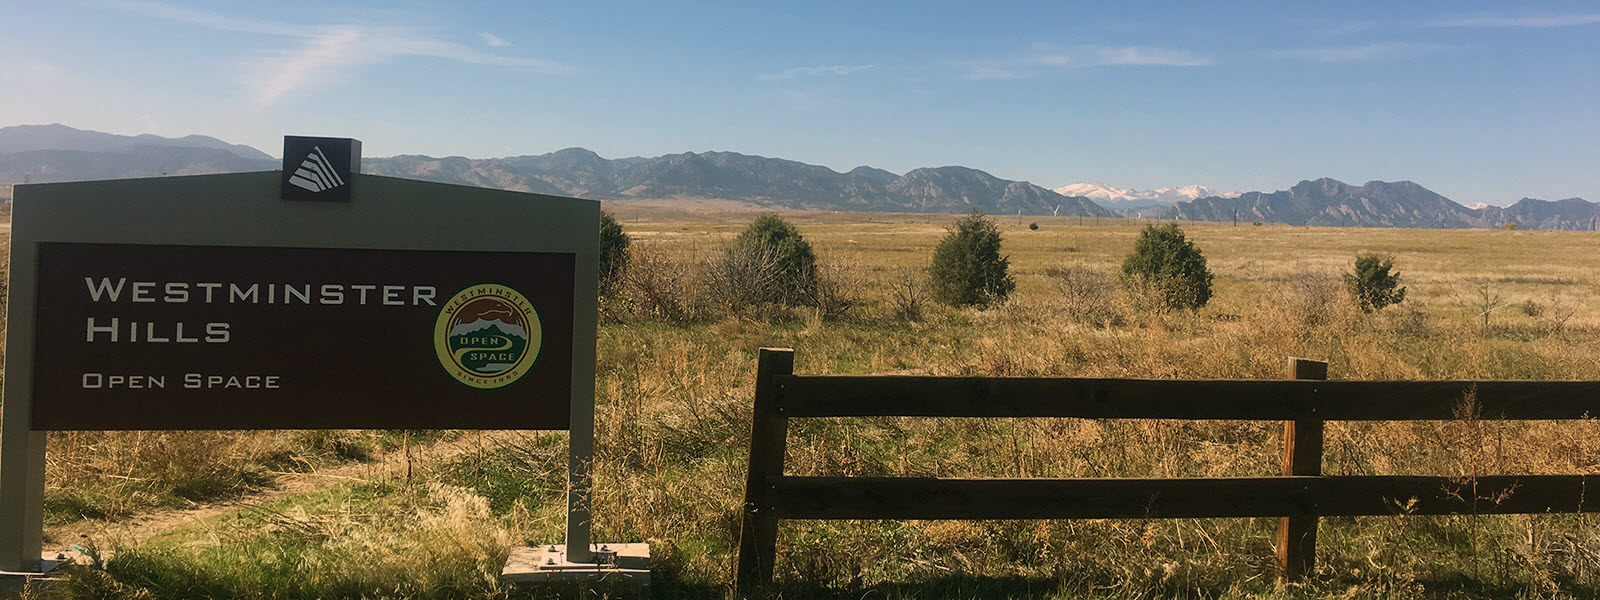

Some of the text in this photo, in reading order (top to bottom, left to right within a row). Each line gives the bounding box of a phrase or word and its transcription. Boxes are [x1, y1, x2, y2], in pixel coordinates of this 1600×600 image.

[85, 277, 438, 306] WESTMINSTER
[445, 287, 532, 316] WESTMINSTER
[86, 317, 231, 343] HILLS
[460, 337, 499, 345] OPEN
[470, 353, 515, 361] SPACE
[82, 373, 281, 389] OPEN SPACE
[457, 371, 487, 384] SINCE
